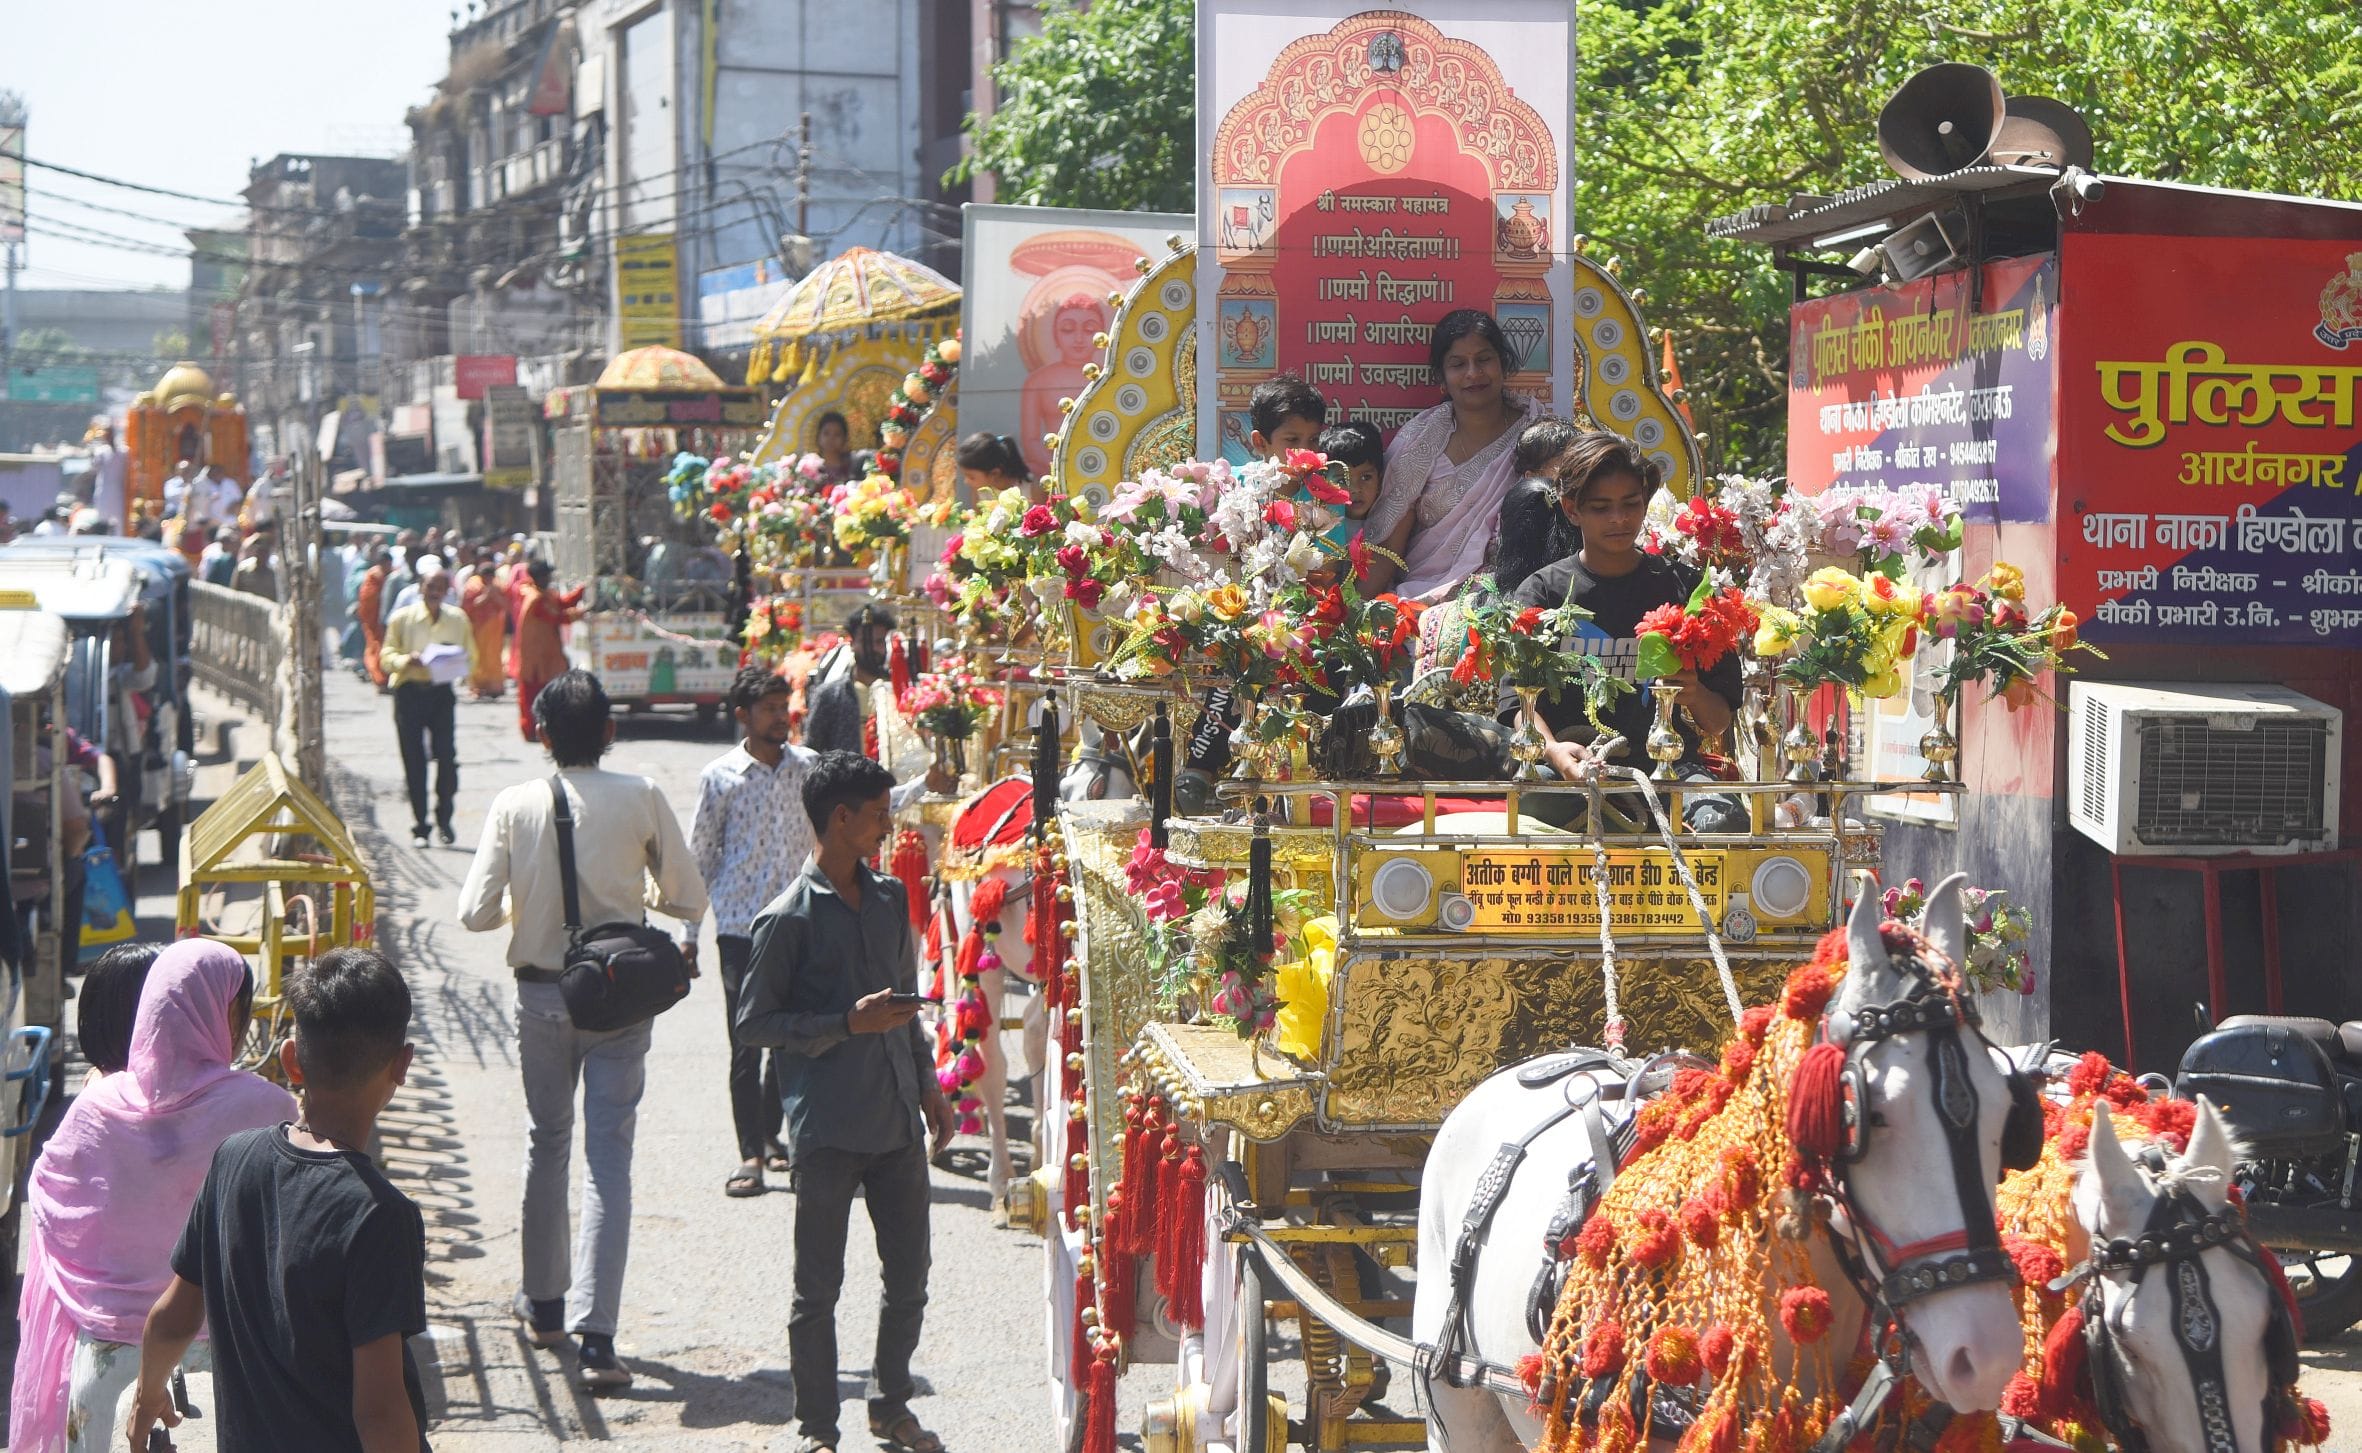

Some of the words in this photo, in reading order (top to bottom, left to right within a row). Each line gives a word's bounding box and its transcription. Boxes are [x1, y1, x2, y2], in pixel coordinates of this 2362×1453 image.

[1317, 190, 1335, 213] श्री
[1340, 196, 1397, 213] नमस्कार
[1401, 191, 1449, 215] महामंत्र
[1364, 314, 1437, 345] आयरिया
[1812, 313, 1849, 396] पुलिस
[1851, 303, 1885, 370] चौकी
[1887, 296, 1955, 368] आर्यनगर
[1359, 363, 1435, 390] उवज्झाय
[2096, 341, 2362, 448] पुलिस
[1819, 403, 1842, 434] थाना
[1843, 400, 1868, 432] नाका
[2178, 441, 2348, 487] आर्यनगर
[2083, 512, 2148, 549] थाना
[2155, 514, 2229, 551] नाका
[2236, 503, 2345, 554] हिण्डोला
[2097, 565, 2159, 592] प्रभारी
[2172, 565, 2259, 593] निरीक्षक
[2301, 568, 2362, 595] श्रीकां
[2096, 598, 2151, 625] चौकी
[2157, 600, 2218, 627] प्रभारी
[2224, 602, 2280, 627] उ.नि.
[1466, 858, 1506, 886] अतीक
[1511, 858, 1541, 886] बग्गी
[1546, 858, 1573, 886] वाले
[1695, 858, 1718, 886] बैन्ड
[1487, 890, 1503, 905] पार्क
[1507, 894, 1522, 910] फूल
[1546, 890, 1555, 905] के
